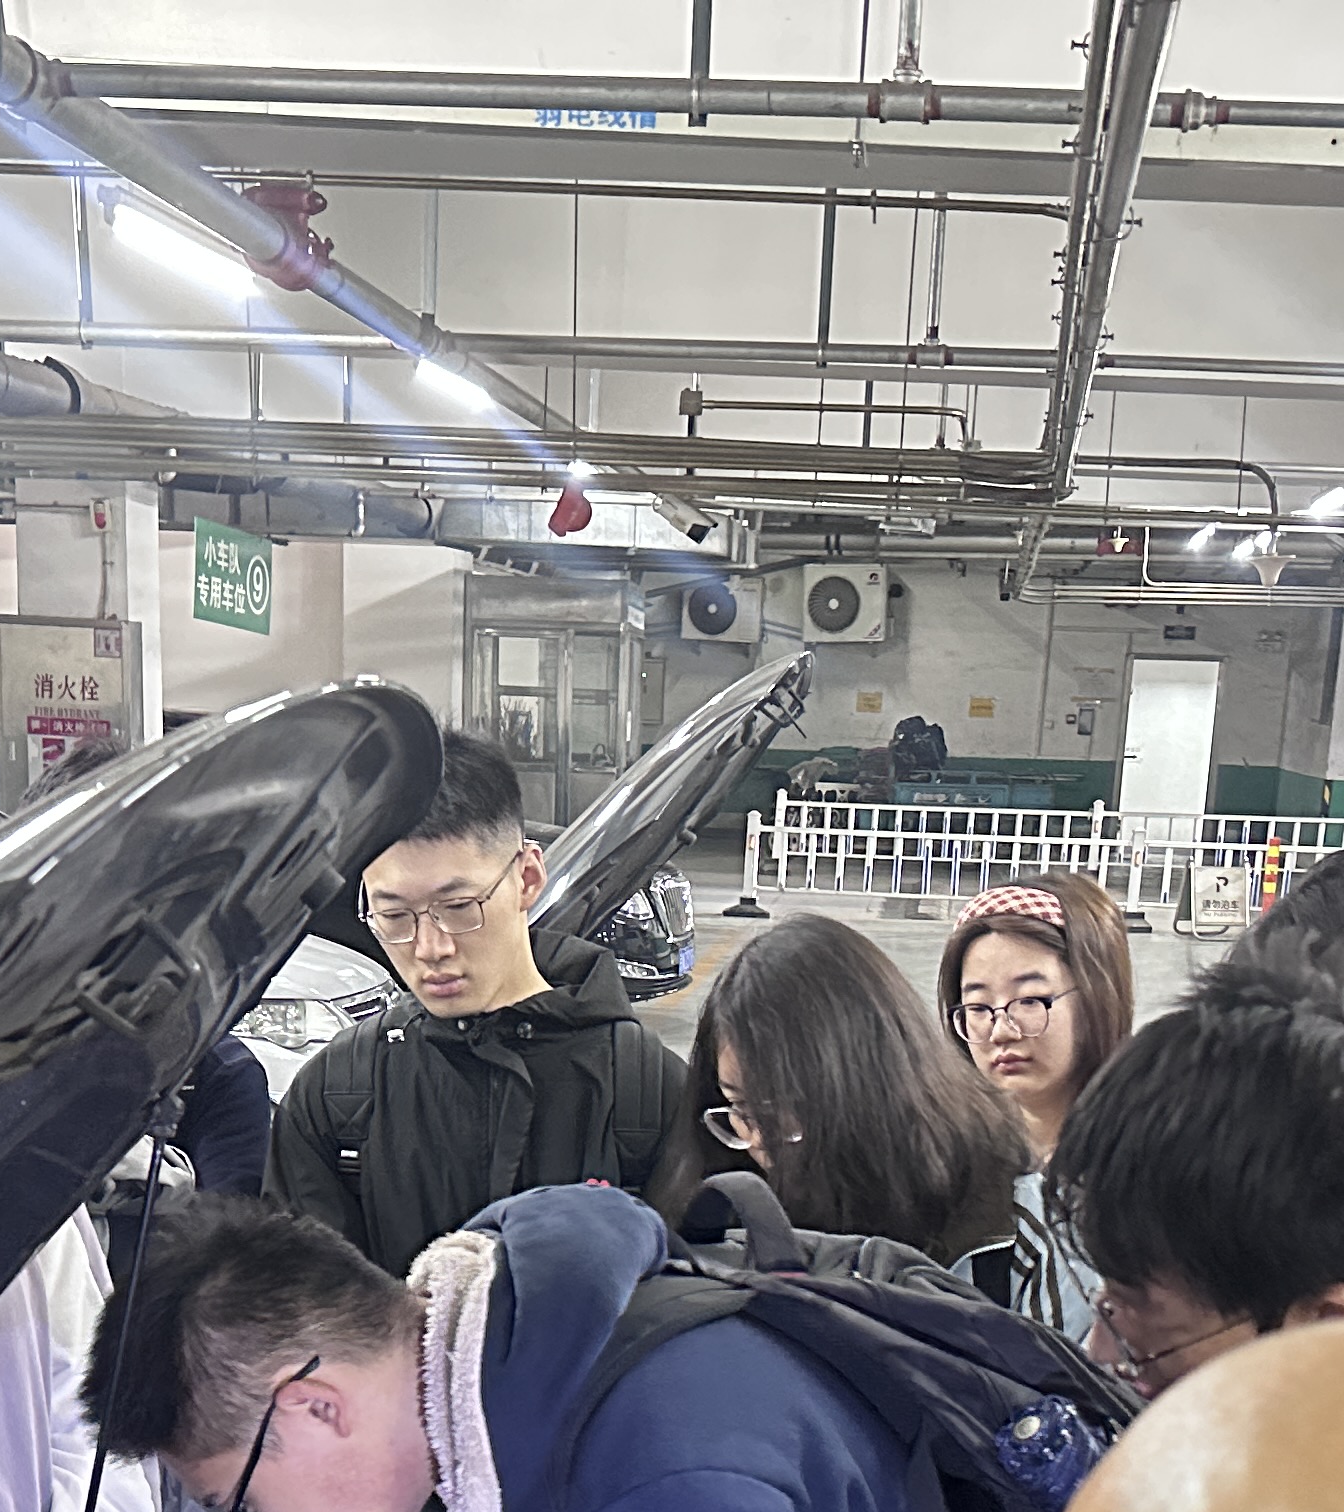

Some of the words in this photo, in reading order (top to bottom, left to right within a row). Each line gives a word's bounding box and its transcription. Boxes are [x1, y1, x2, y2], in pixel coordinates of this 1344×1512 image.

[204, 535, 241, 575] 小车队
[197, 573, 246, 614] 专用车位
[34, 673, 99, 701] 消火栓
[35, 706, 54, 717] FIRE
